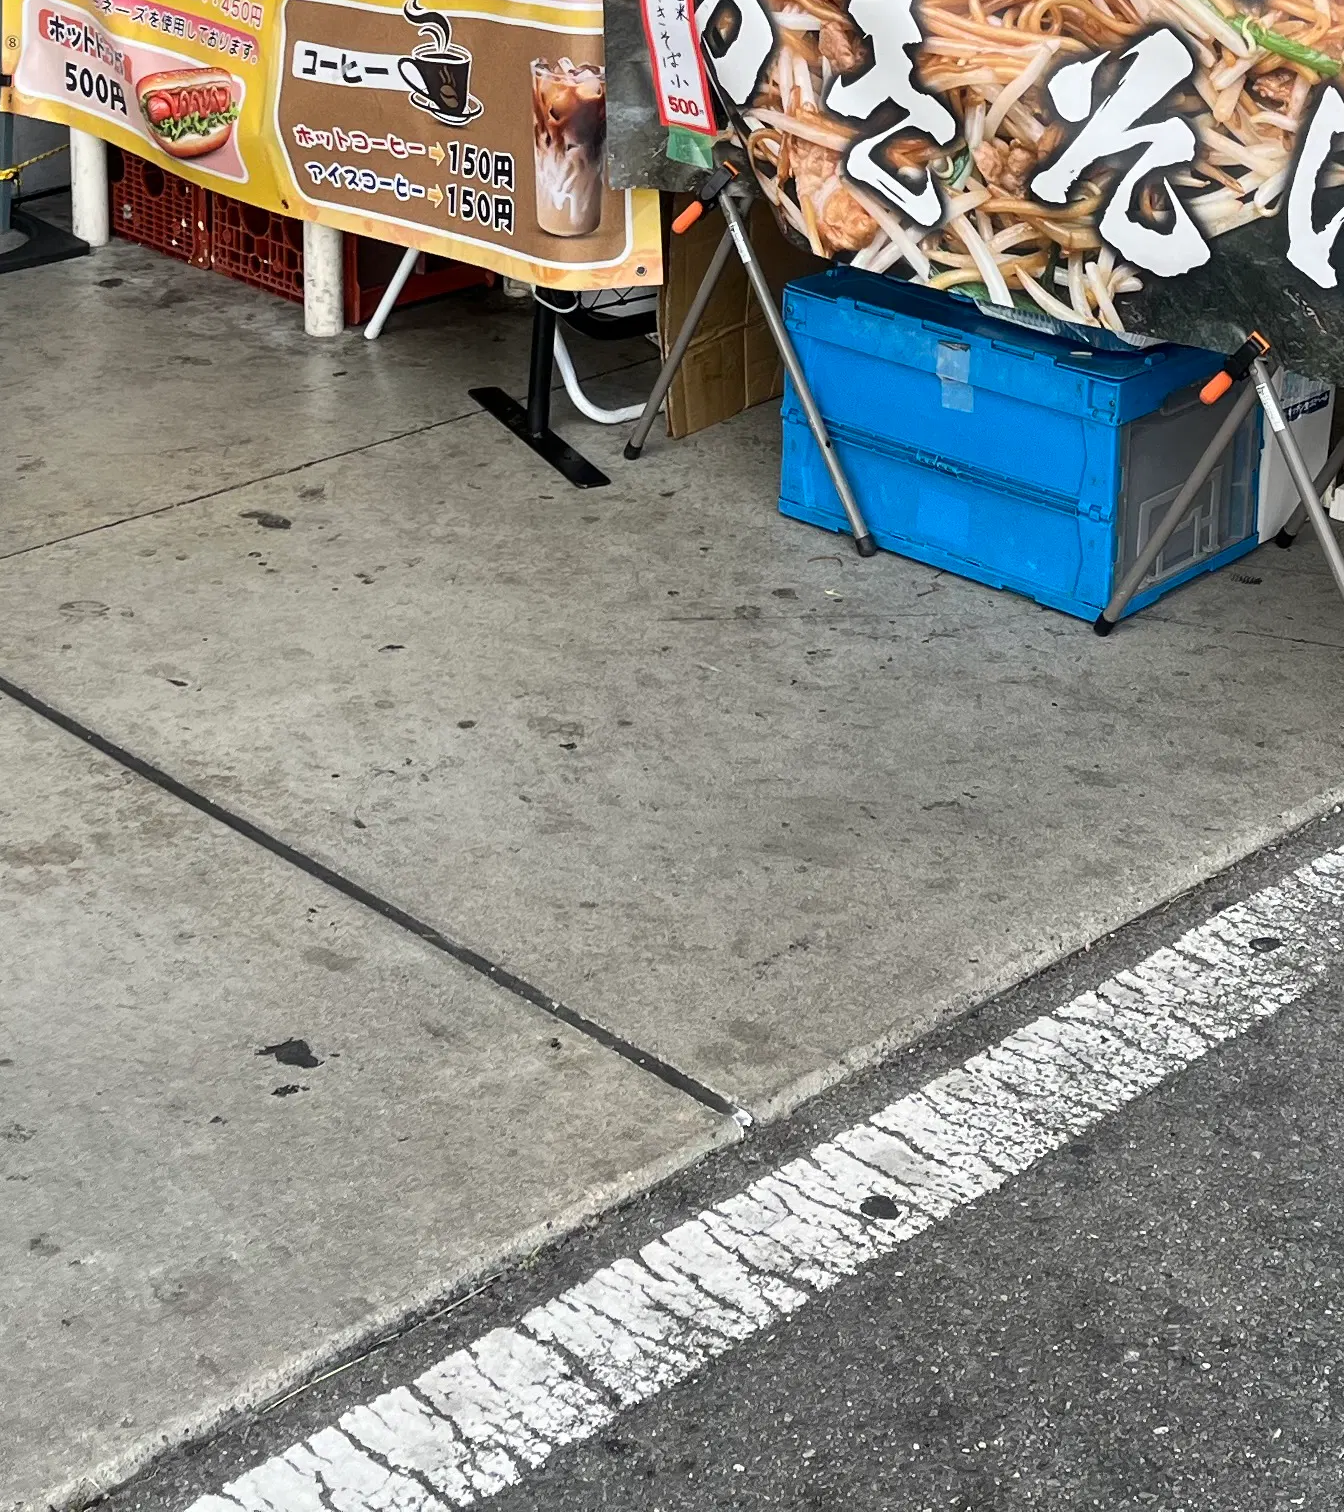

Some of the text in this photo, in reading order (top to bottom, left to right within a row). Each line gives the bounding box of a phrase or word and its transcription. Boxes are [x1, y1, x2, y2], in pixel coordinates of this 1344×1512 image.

[65, 62, 128, 116] 500円
[303, 50, 389, 84] コーヒー
[294, 126, 514, 191] ホットコーヒー 150円
[306, 163, 514, 233] アイスコーヒー 150円
